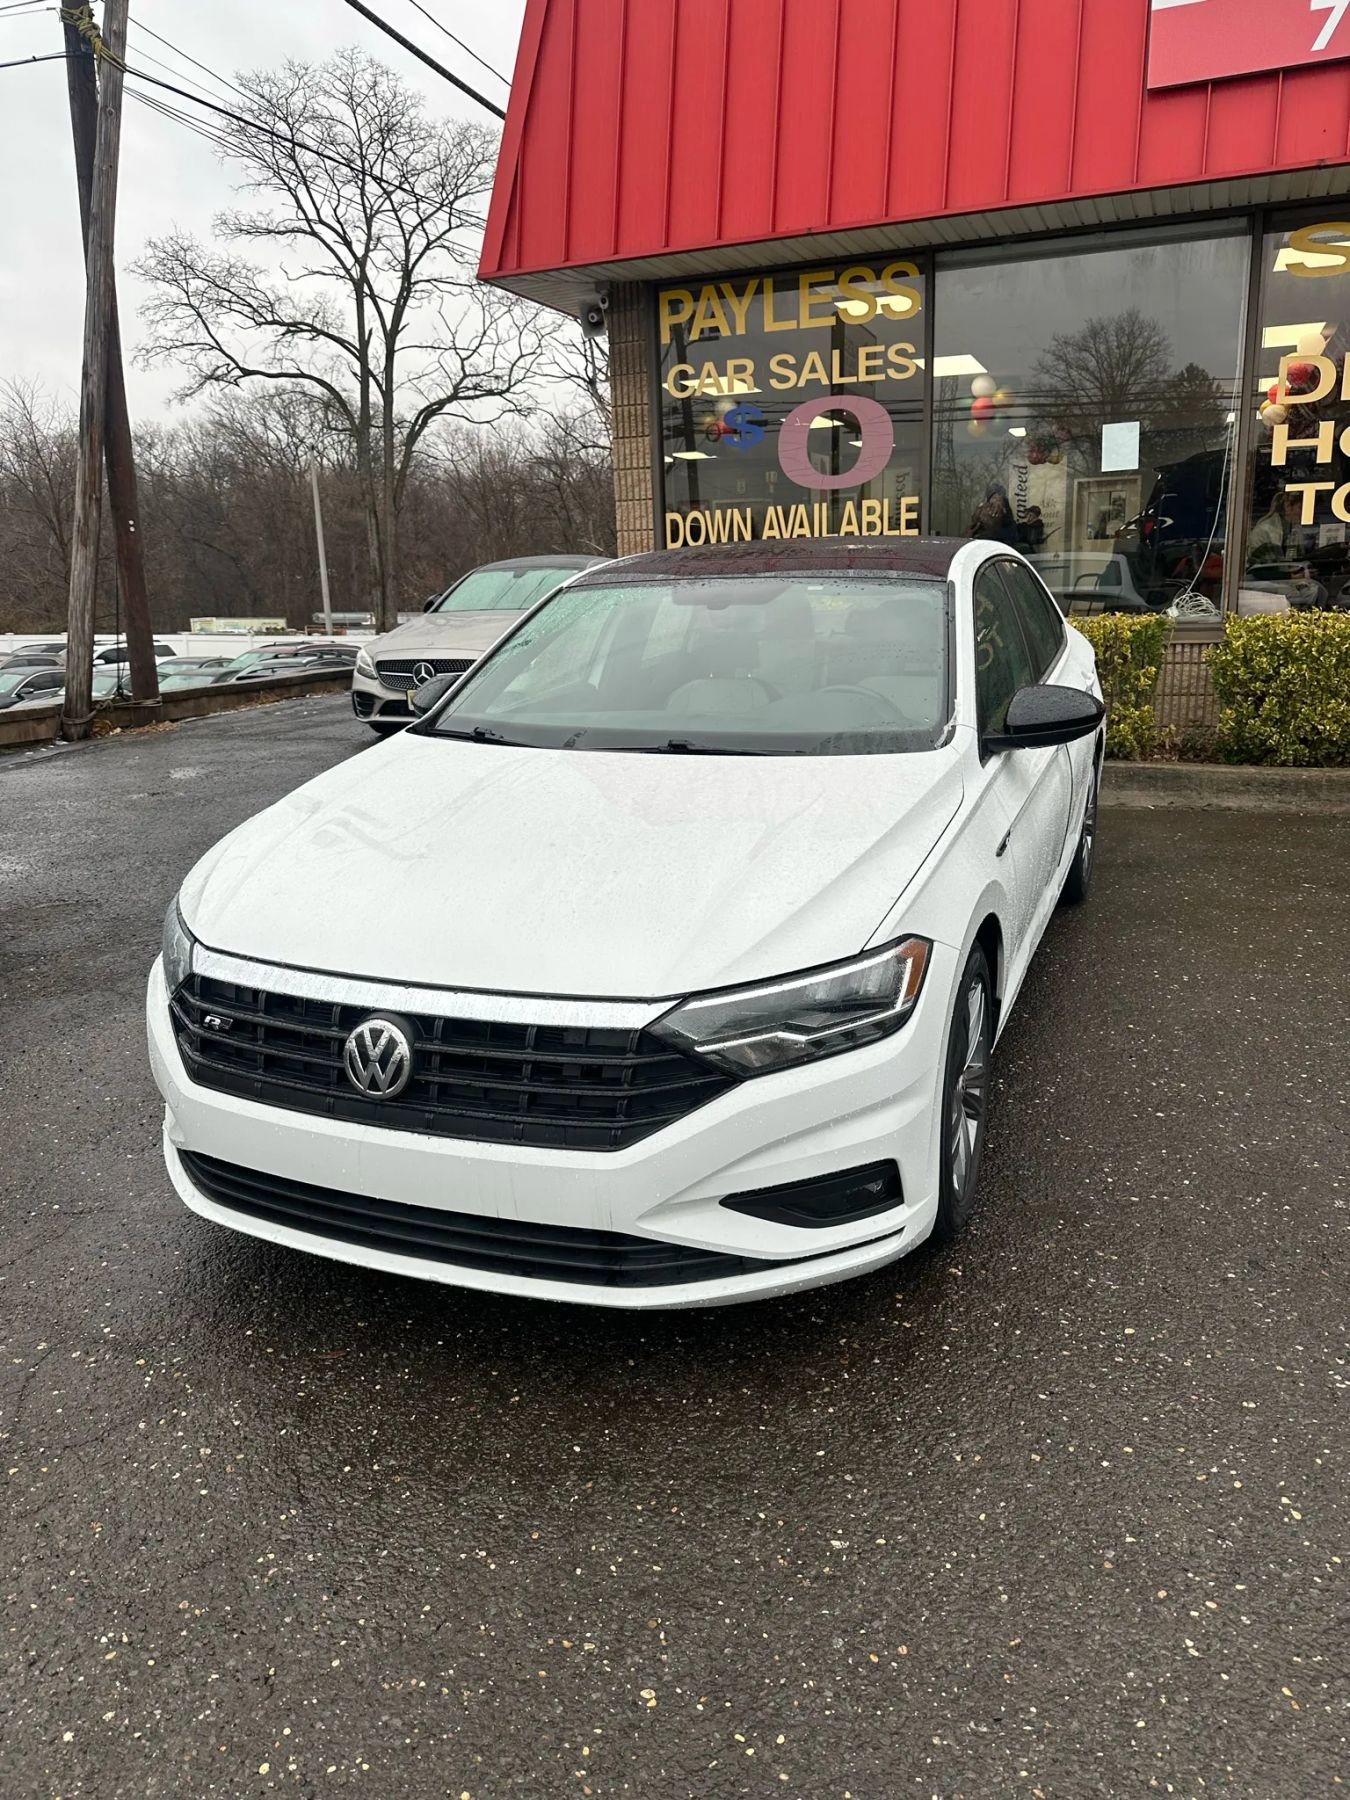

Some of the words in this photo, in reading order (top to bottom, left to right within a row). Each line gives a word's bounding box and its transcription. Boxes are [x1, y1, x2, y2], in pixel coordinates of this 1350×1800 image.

[659, 262, 921, 345] PAYLESS
[667, 358, 755, 399] CAR
[769, 342, 917, 390] SALES
[1270, 420, 1350, 466] H
[665, 507, 752, 550] DOWN
[762, 496, 920, 541] AVAILABLE
